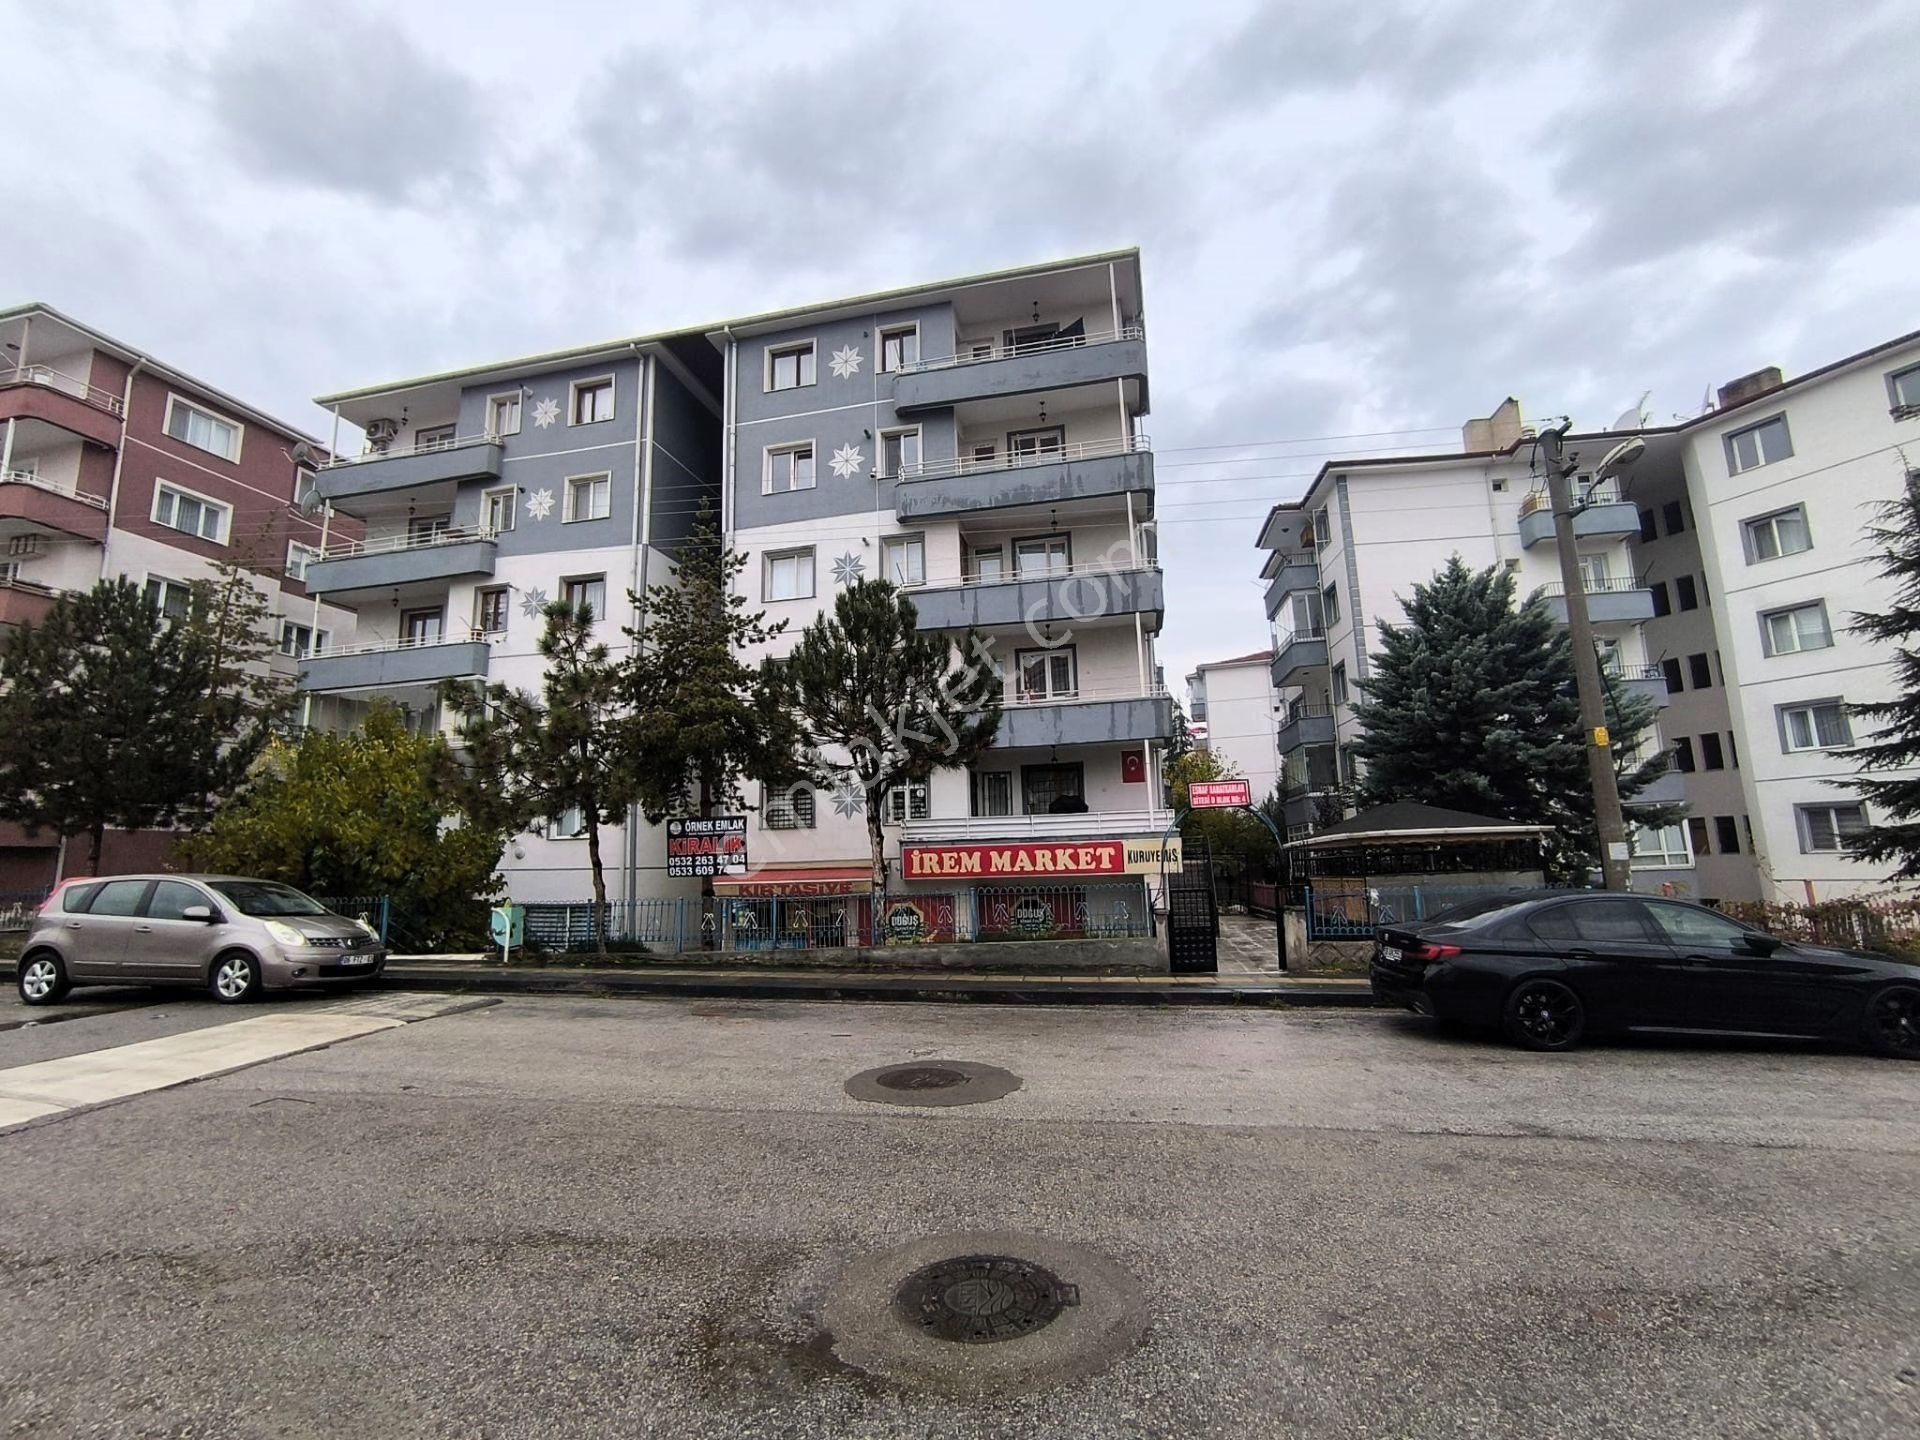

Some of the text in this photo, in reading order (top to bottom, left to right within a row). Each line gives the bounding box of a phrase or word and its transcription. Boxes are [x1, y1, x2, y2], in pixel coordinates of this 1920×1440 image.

[685, 819, 744, 832] ÖRNEK EMLAK
[669, 855, 745, 866] 0532 263 47 04
[911, 847, 1115, 875] İREM MARKET
[669, 867, 693, 876] 0533
[695, 866, 714, 875] 609
